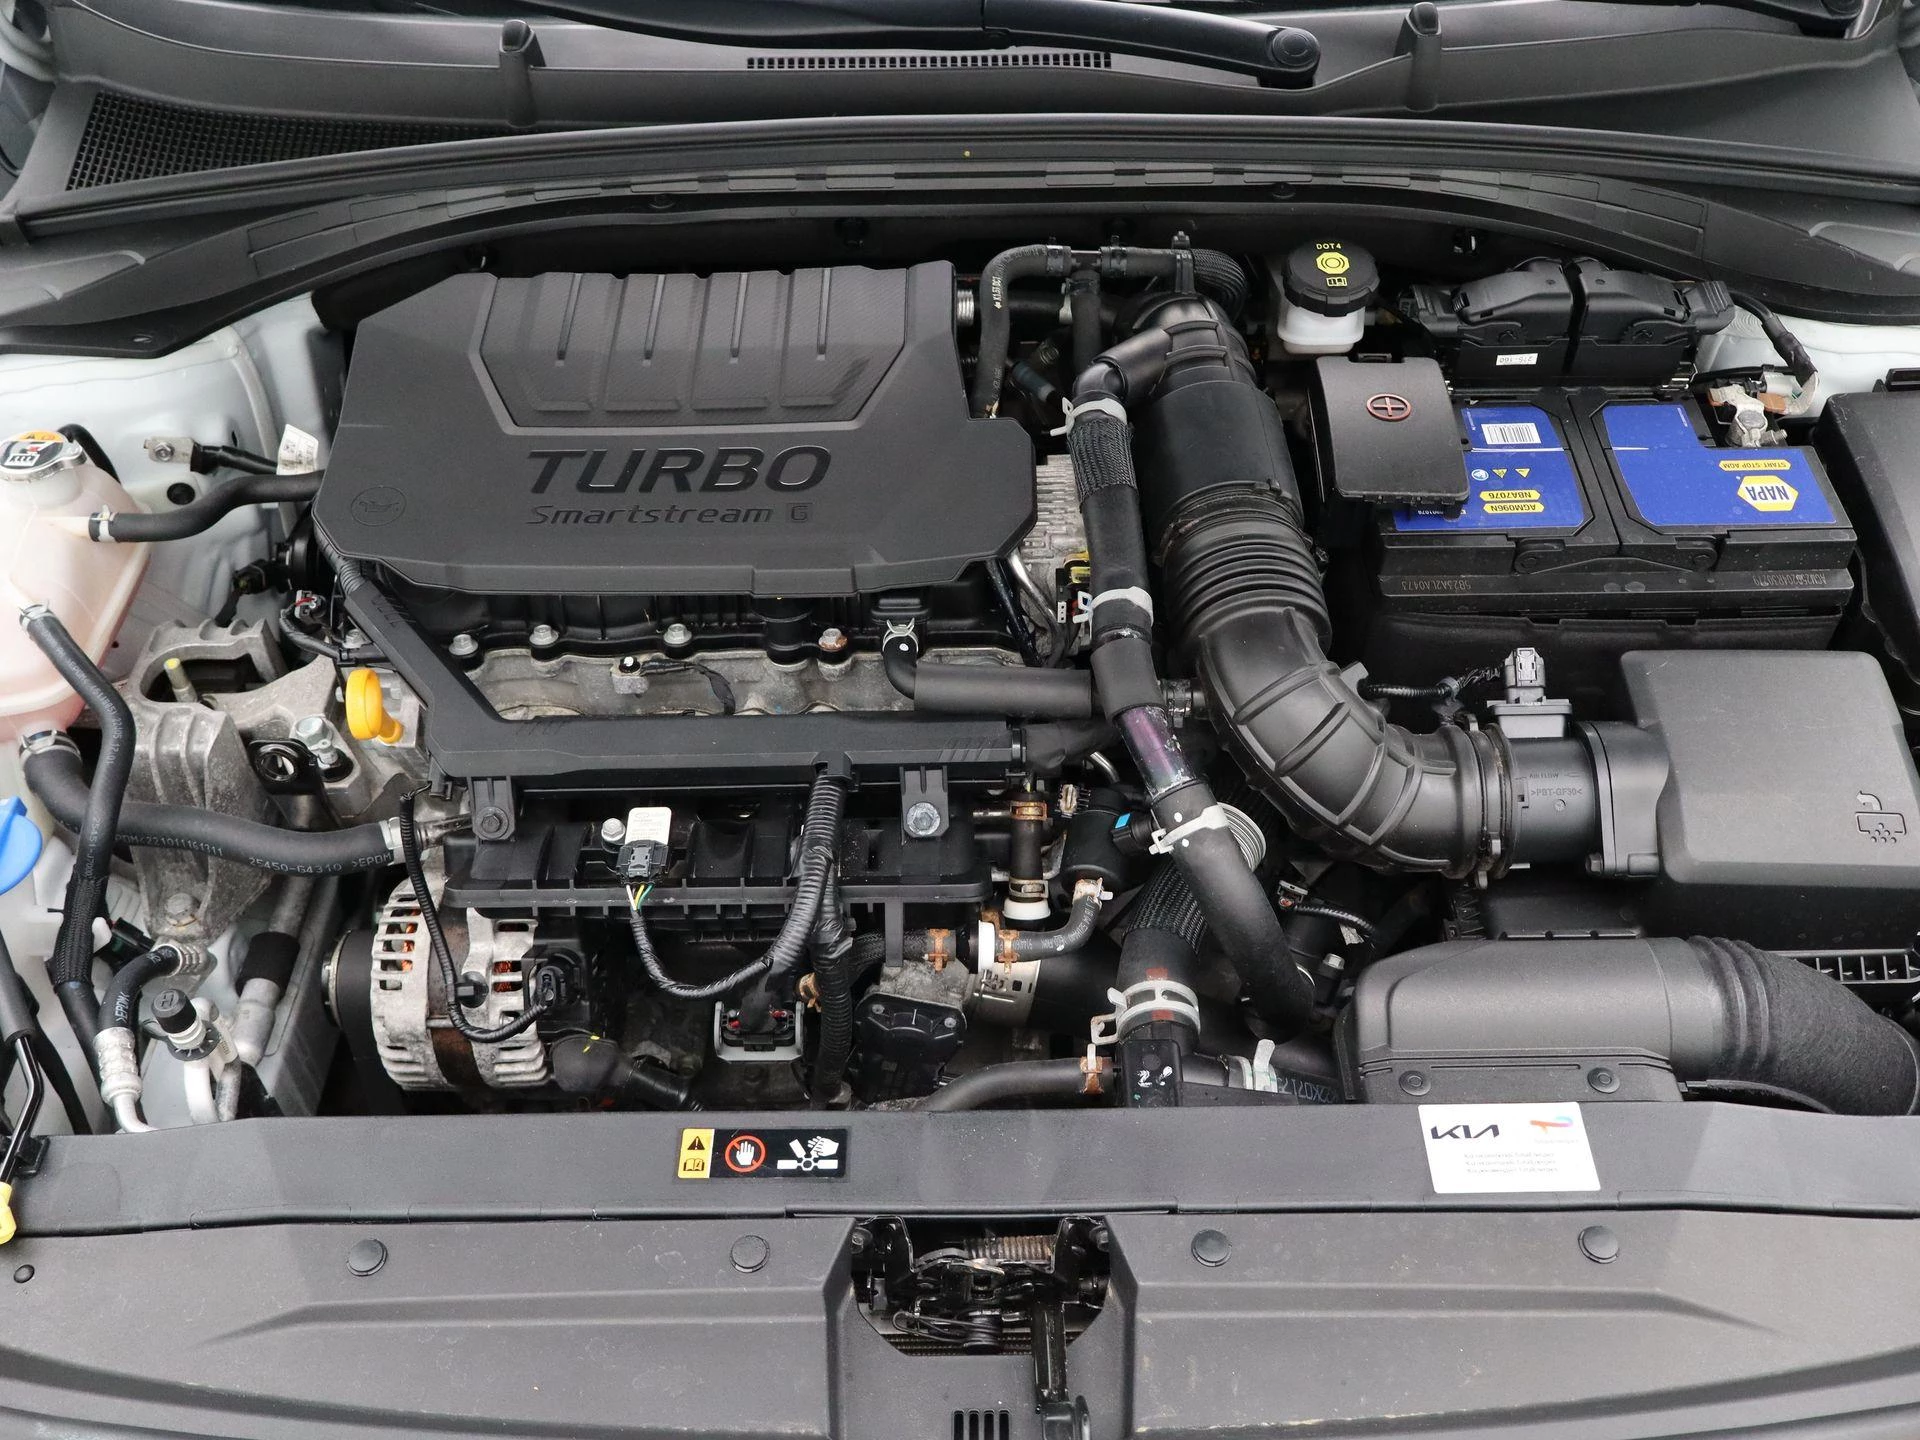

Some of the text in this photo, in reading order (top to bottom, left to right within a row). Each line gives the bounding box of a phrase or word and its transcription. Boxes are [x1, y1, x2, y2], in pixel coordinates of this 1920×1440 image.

[526, 445, 831, 494] TURBO
[1745, 485, 1790, 501] NAPA
[526, 504, 811, 525] Smartstream G
[1430, 1124, 1500, 1139] KIA
